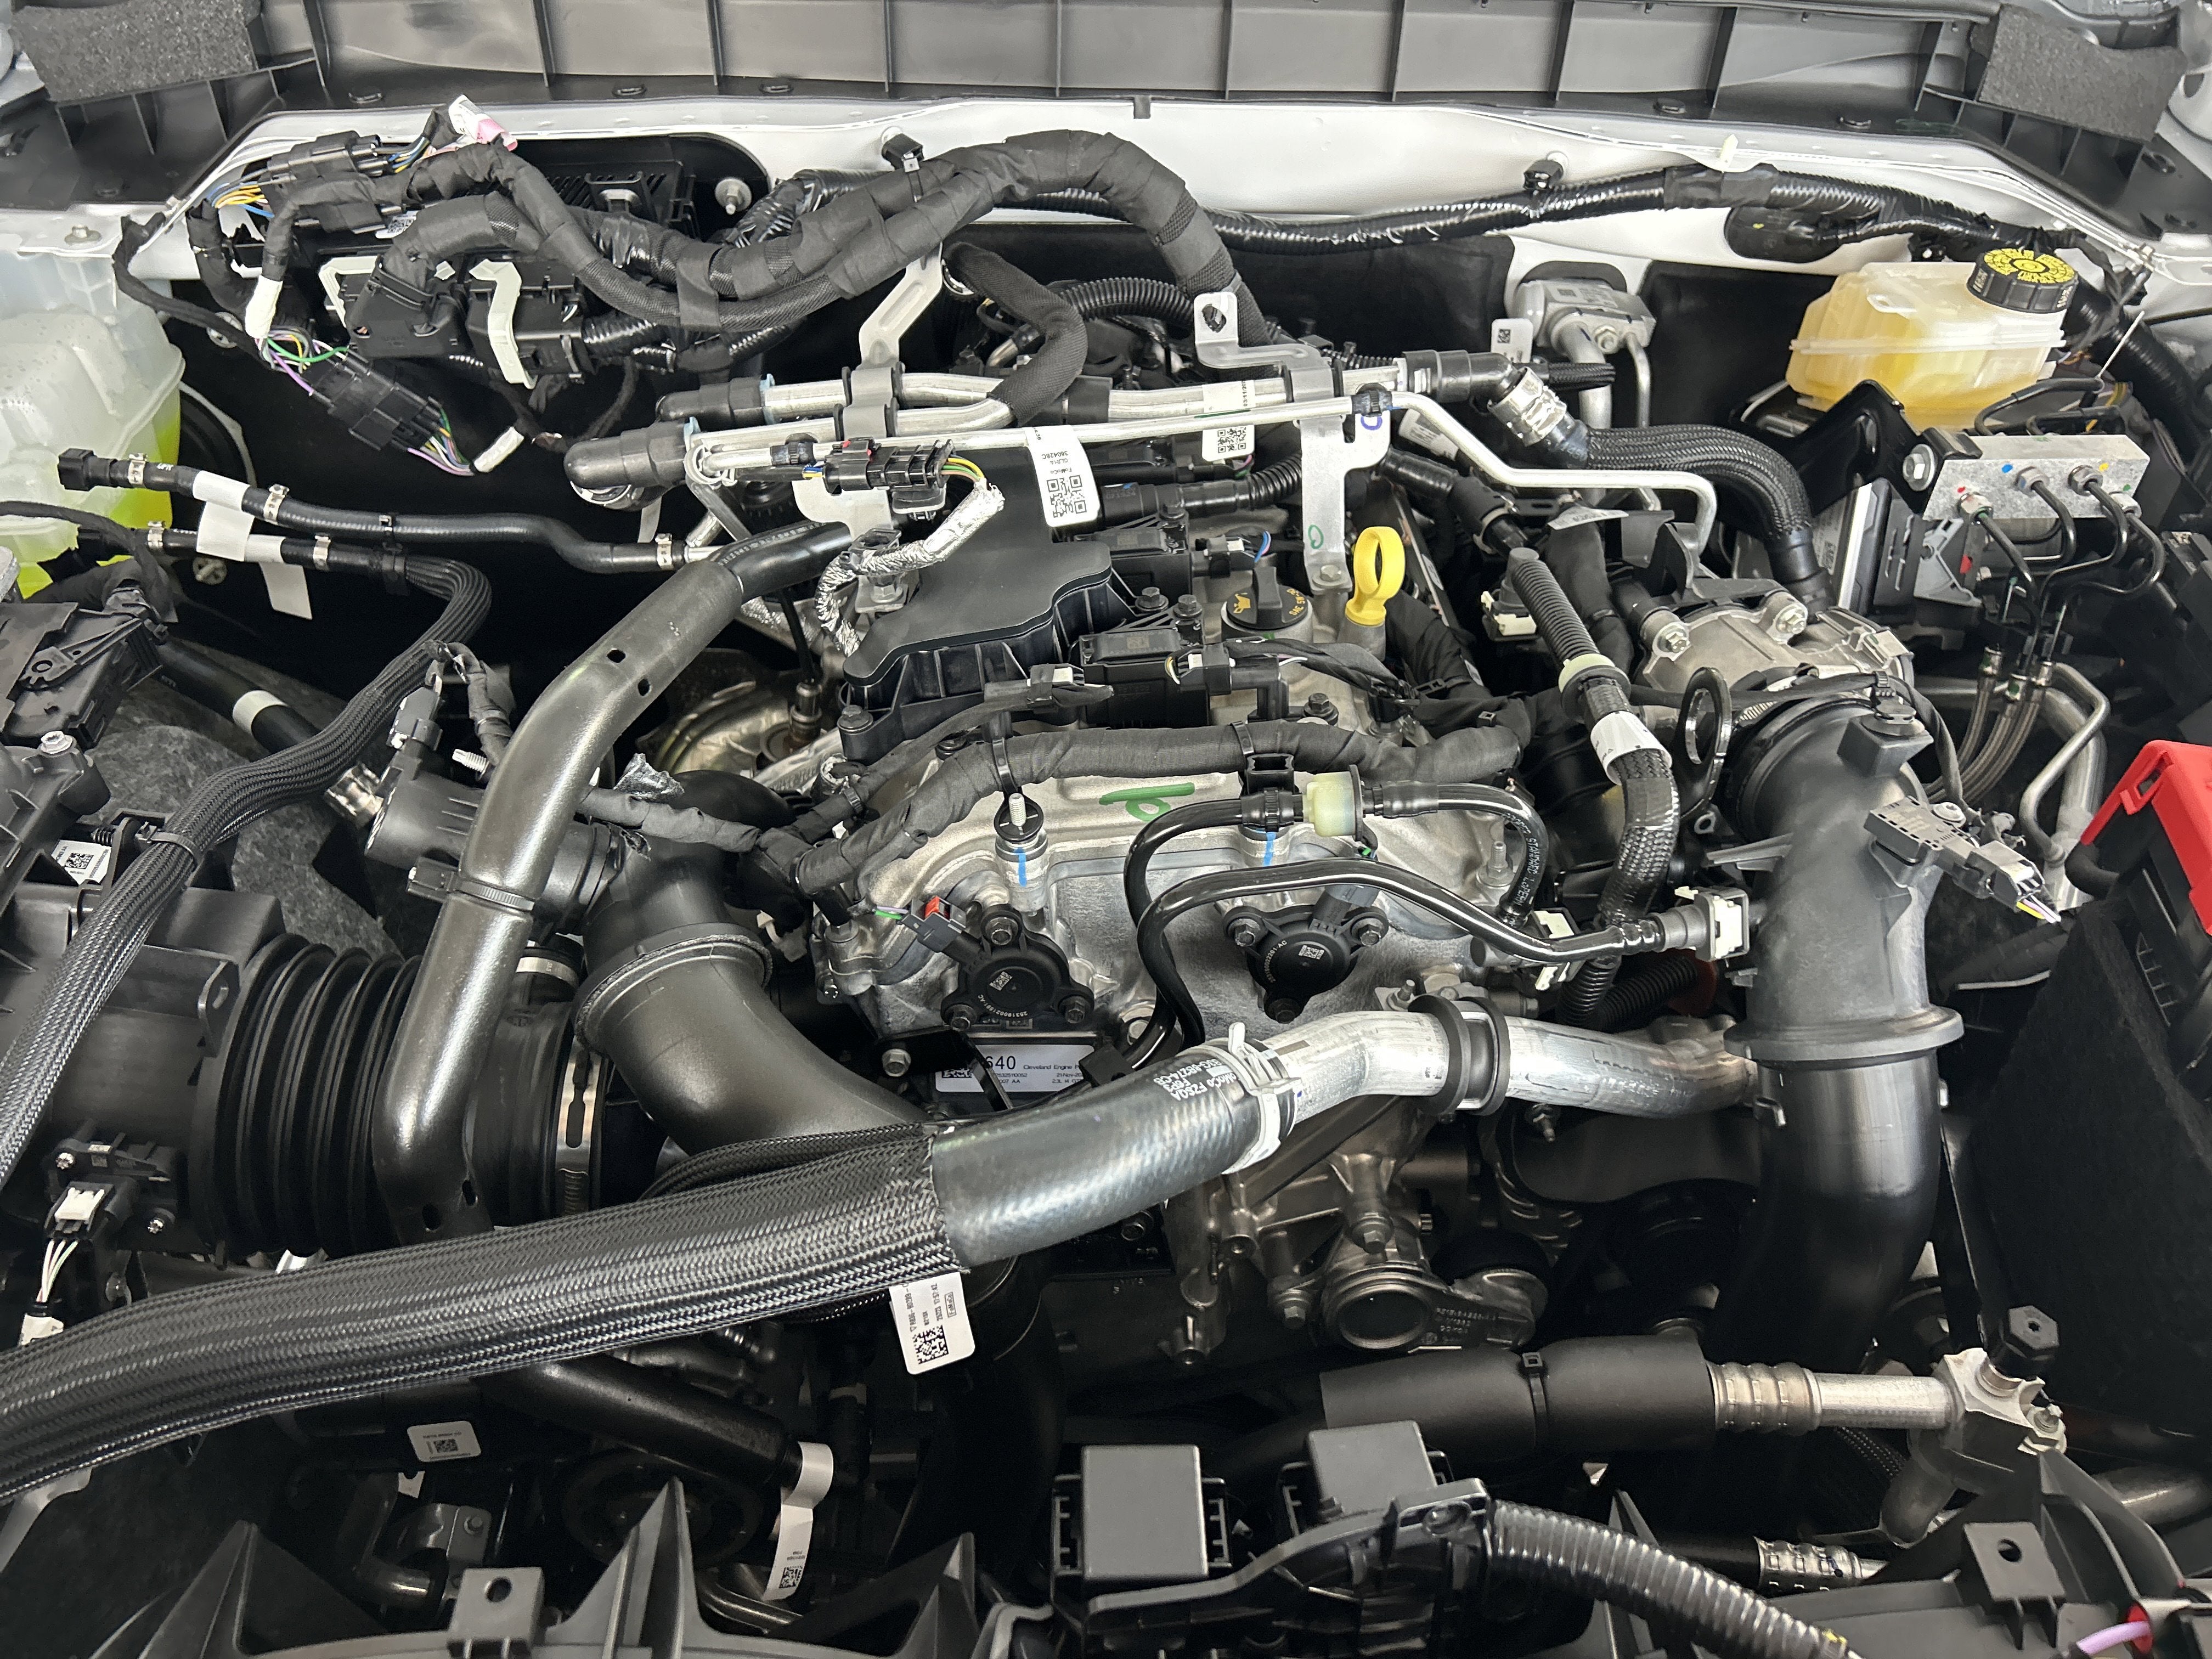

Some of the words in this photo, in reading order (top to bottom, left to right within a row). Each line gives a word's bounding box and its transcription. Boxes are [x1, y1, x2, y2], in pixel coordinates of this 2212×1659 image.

[1289, 606, 1304, 616] SAE
[1206, 1073, 1237, 1088] oMoCo
[946, 1294, 955, 1315] FoMoCo
